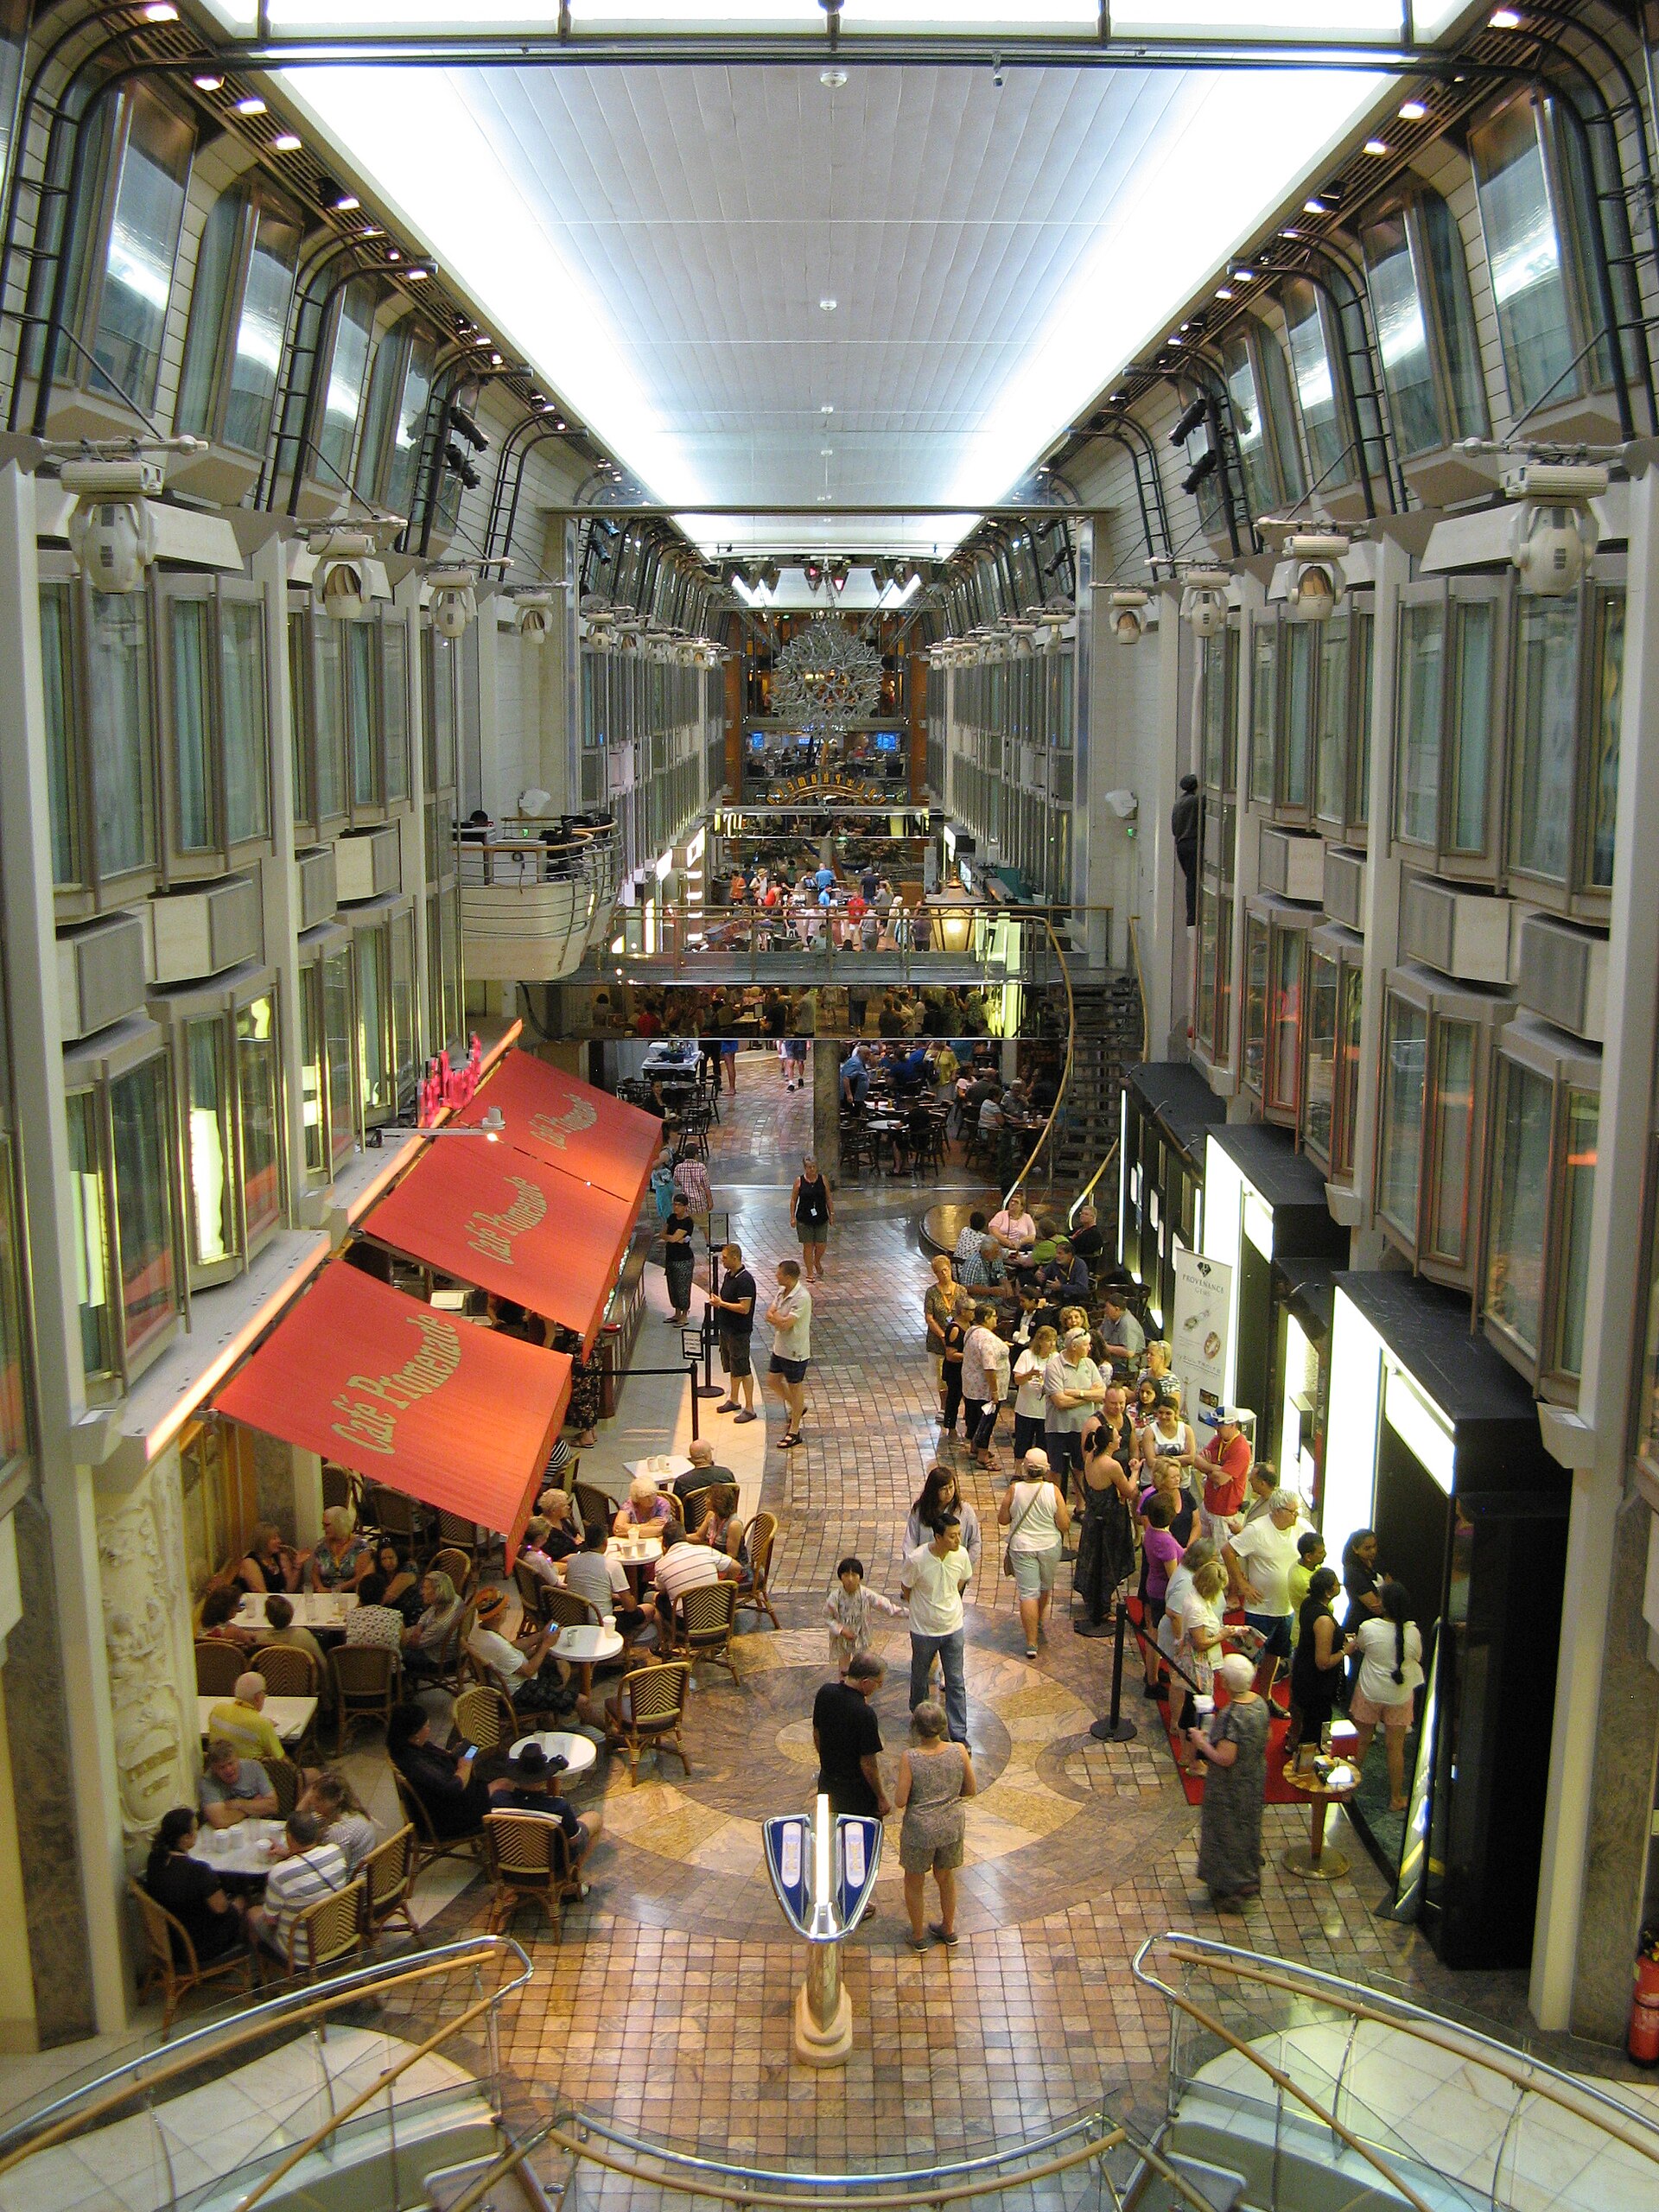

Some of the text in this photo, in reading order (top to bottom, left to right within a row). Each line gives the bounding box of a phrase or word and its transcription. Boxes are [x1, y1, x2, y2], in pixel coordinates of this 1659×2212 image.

[463, 1175, 548, 1265] Café Promenade
[1182, 1274, 1225, 1294] PROVENANCE
[331, 1313, 462, 1454] Café Promenade
